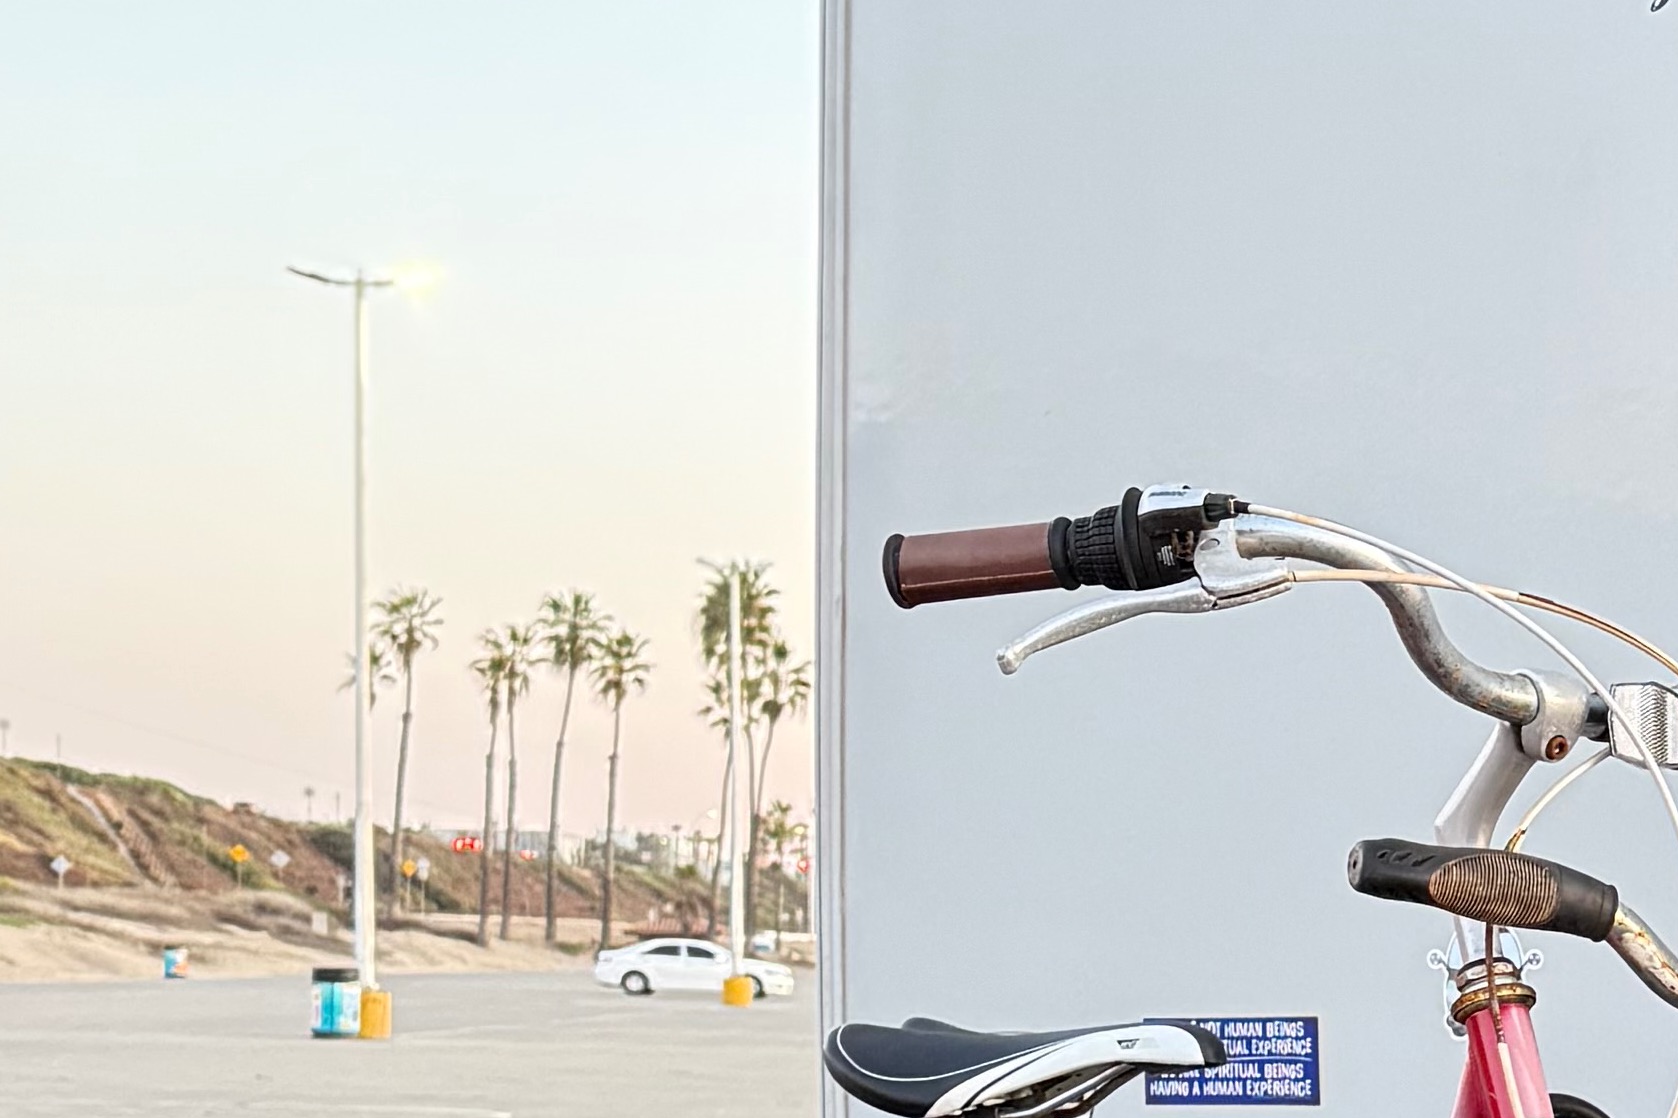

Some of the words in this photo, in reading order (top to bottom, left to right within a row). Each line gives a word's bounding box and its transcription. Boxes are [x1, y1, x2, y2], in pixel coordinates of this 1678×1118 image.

[1224, 1022, 1262, 1037] HUMAN
[1266, 1021, 1304, 1037] BEINGS
[1251, 1037, 1312, 1055] EXPERIENCE
[1204, 1062, 1261, 1078] SPIRITUAL
[1264, 1063, 1304, 1079] BEINGS
[1150, 1080, 1189, 1096] HAVING
[1192, 1080, 1200, 1096] A
[1203, 1080, 1243, 1096] HUMAN
[1246, 1079, 1312, 1097] EXPERIENCE
